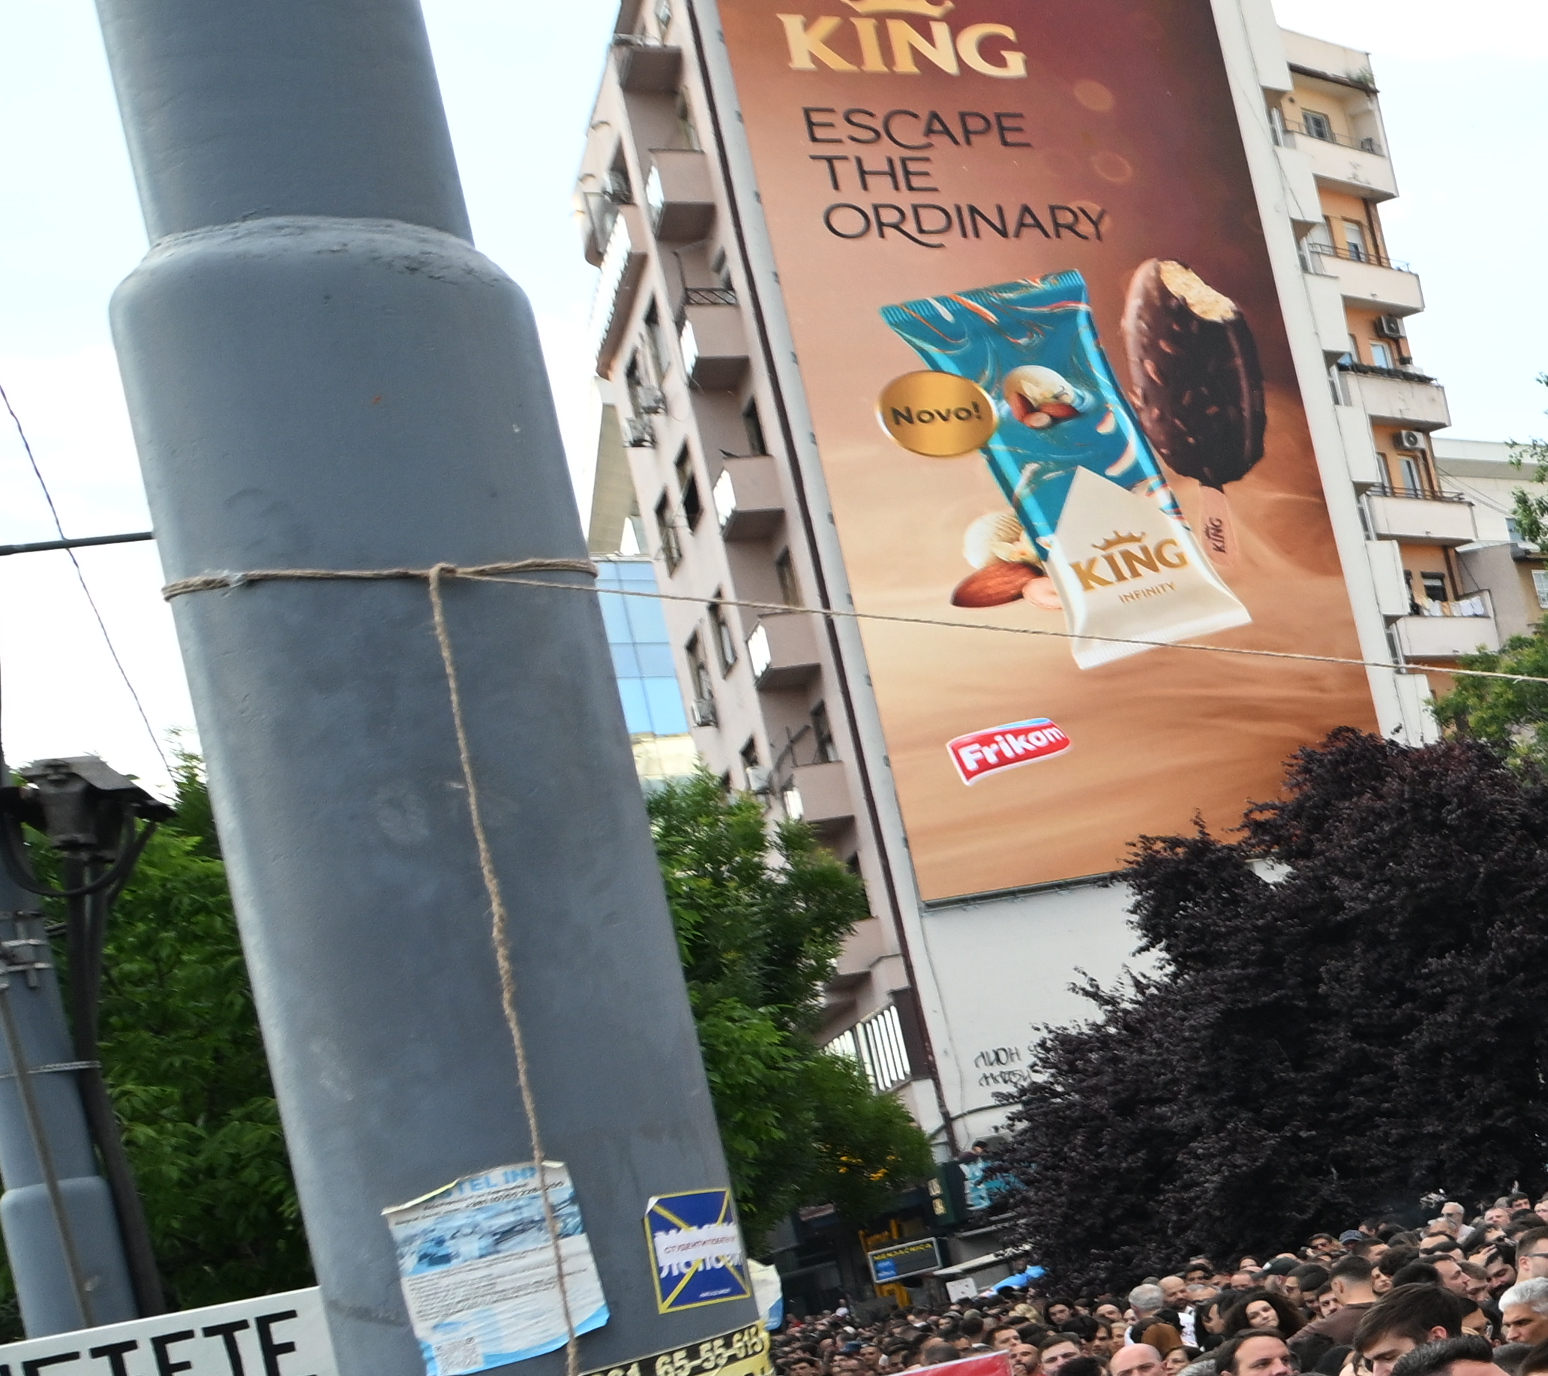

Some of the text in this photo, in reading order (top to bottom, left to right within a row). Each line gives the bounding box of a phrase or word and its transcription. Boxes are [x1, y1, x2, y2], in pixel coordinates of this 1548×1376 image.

[776, 11, 1027, 80] KING
[802, 107, 1034, 151] ESCAPE
[810, 154, 942, 193] THE
[823, 203, 1108, 251] ORDINARY
[889, 398, 984, 431] Novo!
[1072, 535, 1190, 591] KING
[1117, 579, 1177, 606] INFINITY
[959, 723, 1071, 773] Frikom
